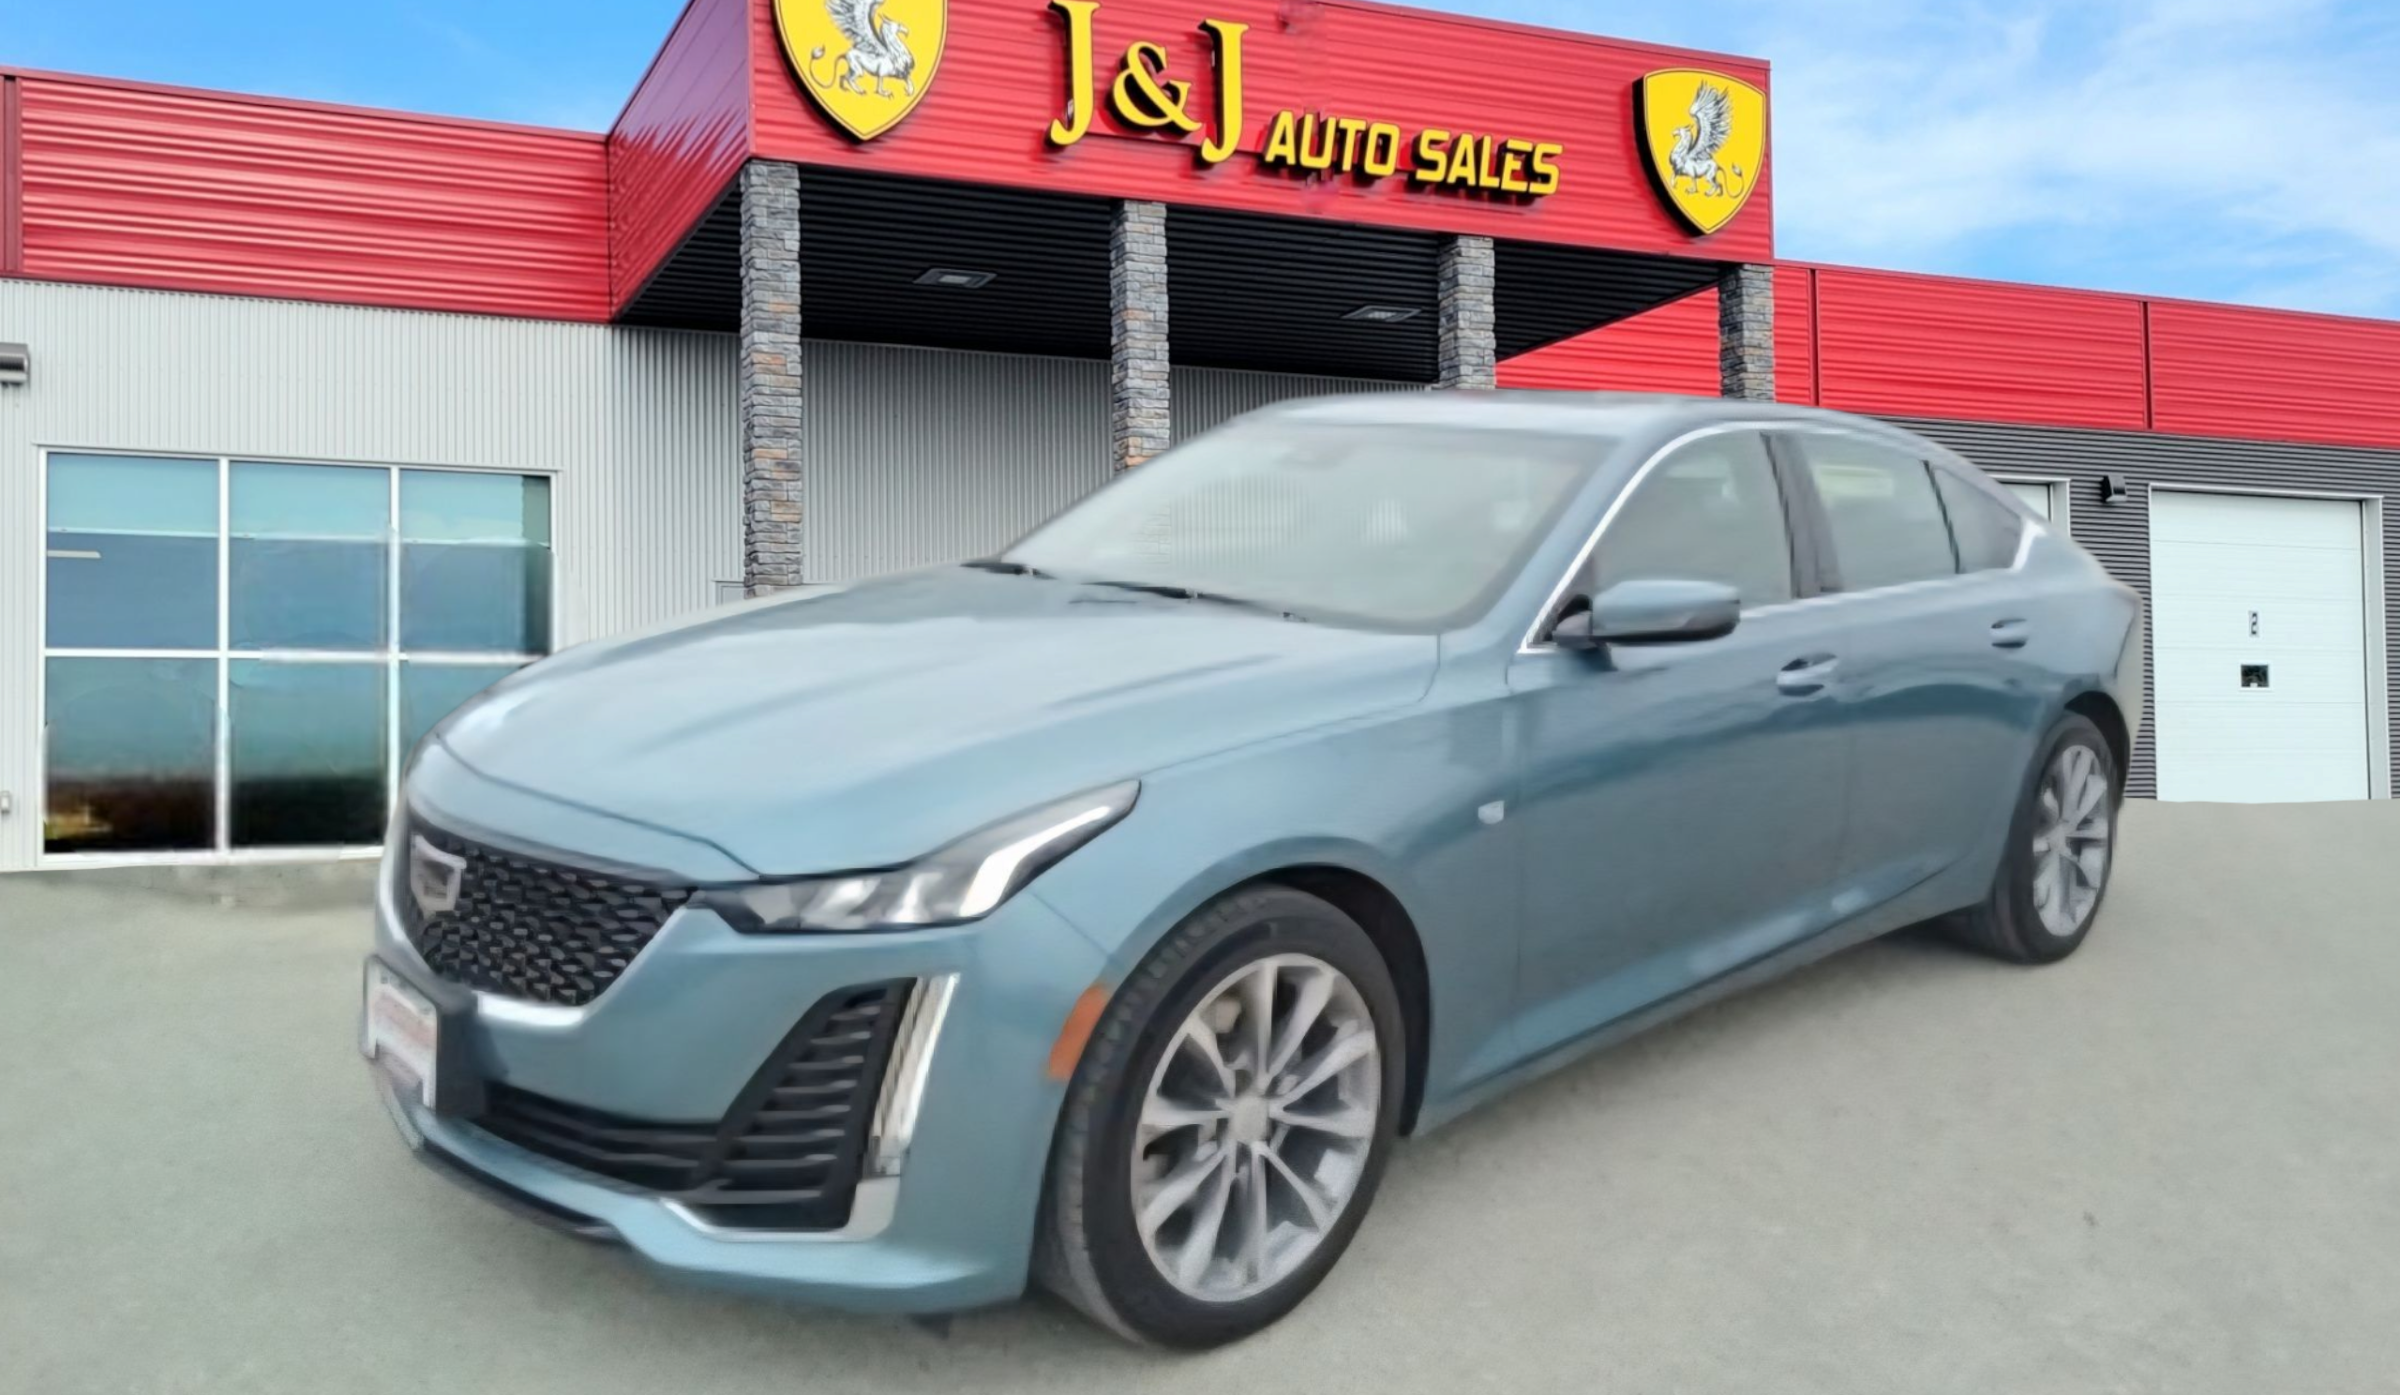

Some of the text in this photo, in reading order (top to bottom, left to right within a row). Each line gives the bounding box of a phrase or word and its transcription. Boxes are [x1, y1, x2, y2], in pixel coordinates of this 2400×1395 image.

[1049, 0, 1564, 195] J&J AUTO SALES
